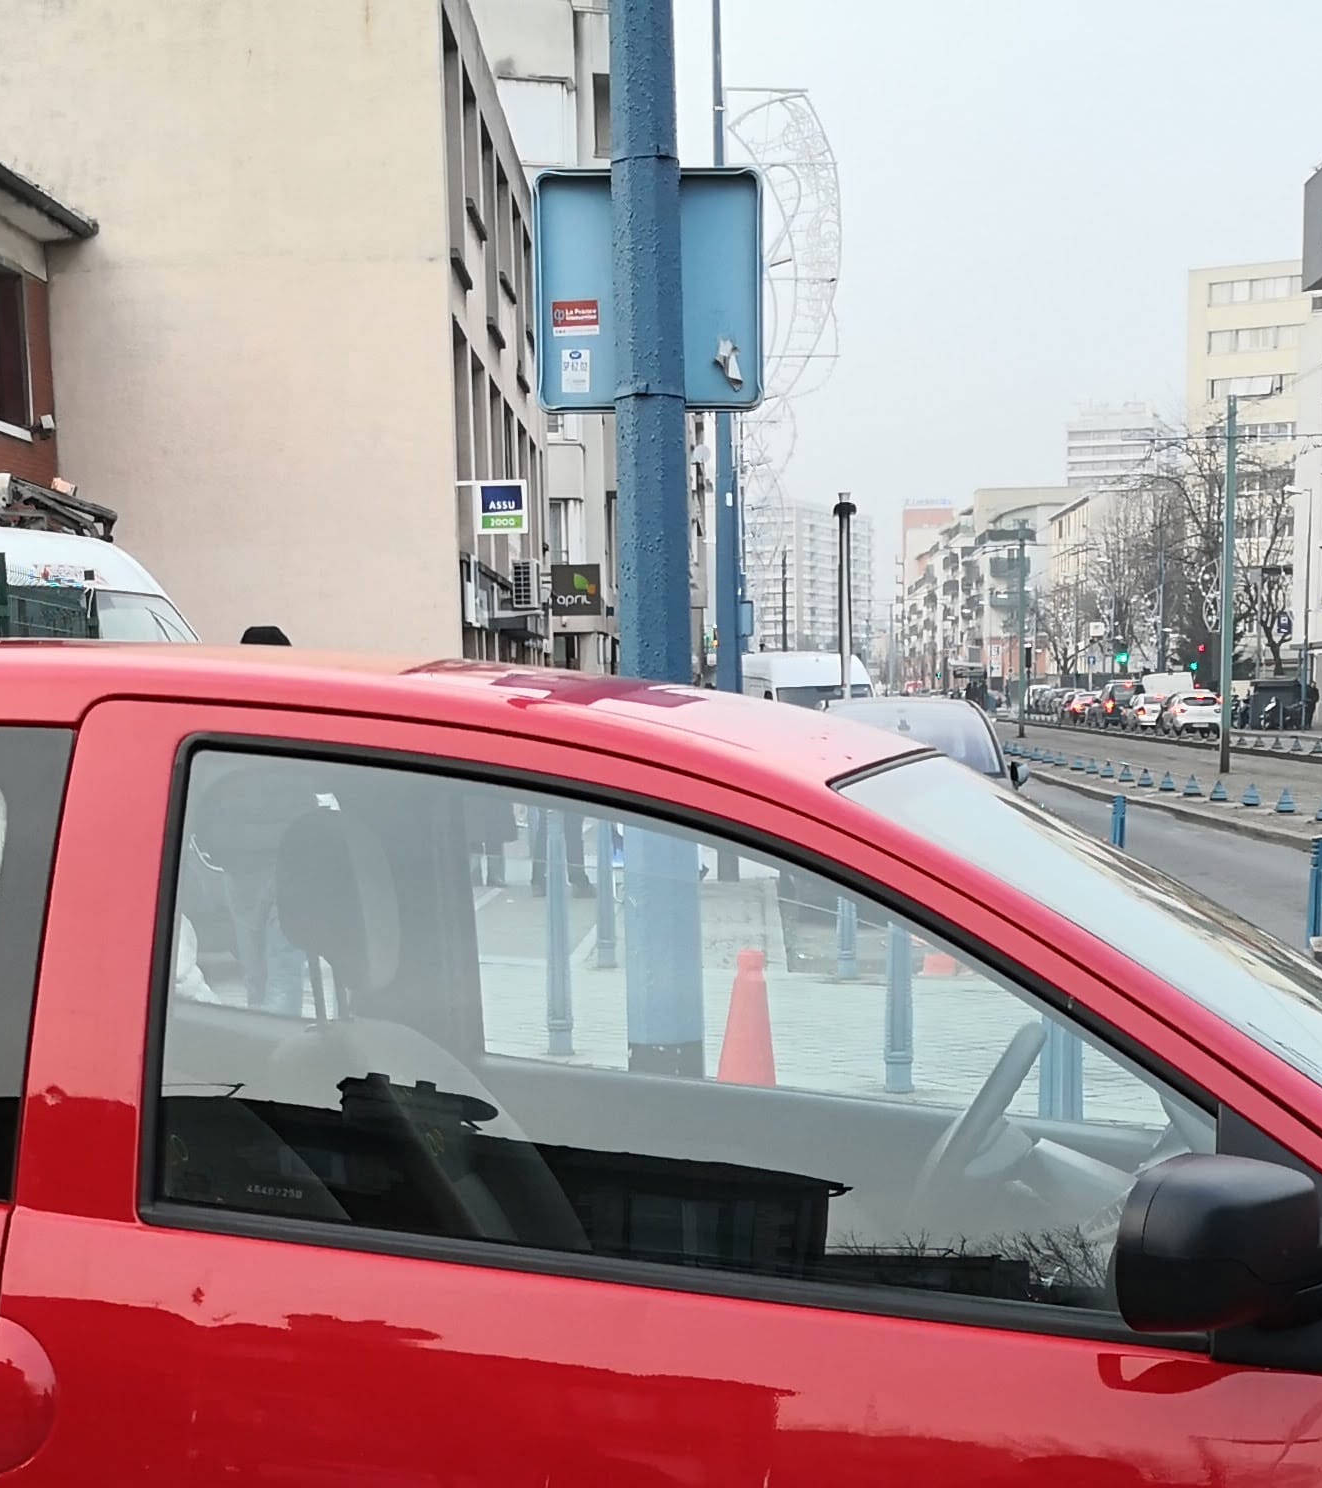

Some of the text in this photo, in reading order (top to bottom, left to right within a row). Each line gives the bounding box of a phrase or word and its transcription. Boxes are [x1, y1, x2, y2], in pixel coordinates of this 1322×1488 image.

[489, 500, 516, 510] ASSU
[490, 518, 516, 526] 2000
[557, 594, 591, 607] april
